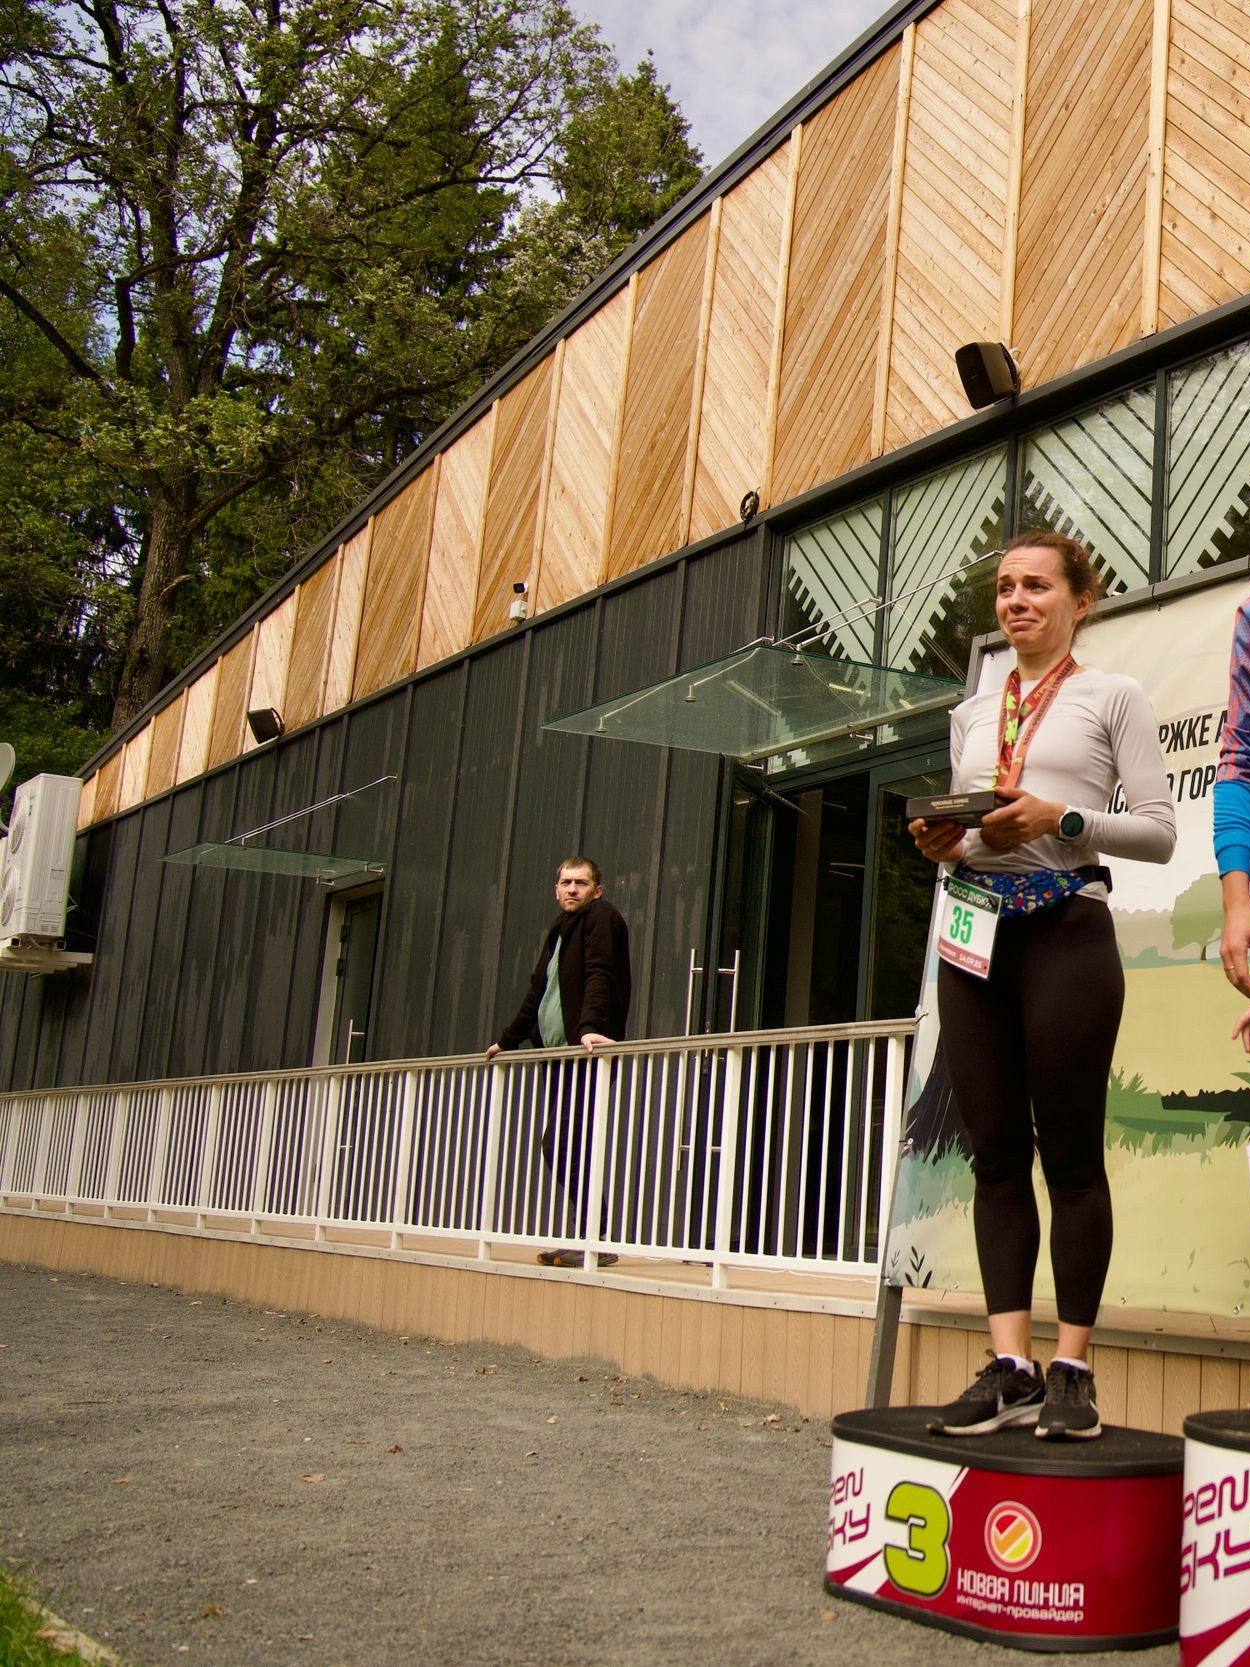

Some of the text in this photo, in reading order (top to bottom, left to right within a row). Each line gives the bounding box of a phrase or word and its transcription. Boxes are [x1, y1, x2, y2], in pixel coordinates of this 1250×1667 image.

[950, 905, 973, 944] 35
[884, 1480, 951, 1598] 3
[957, 1567, 1084, 1608] НОВАЯ ЛИНИЯ
[956, 1594, 1084, 1623] интернет-провайдер
